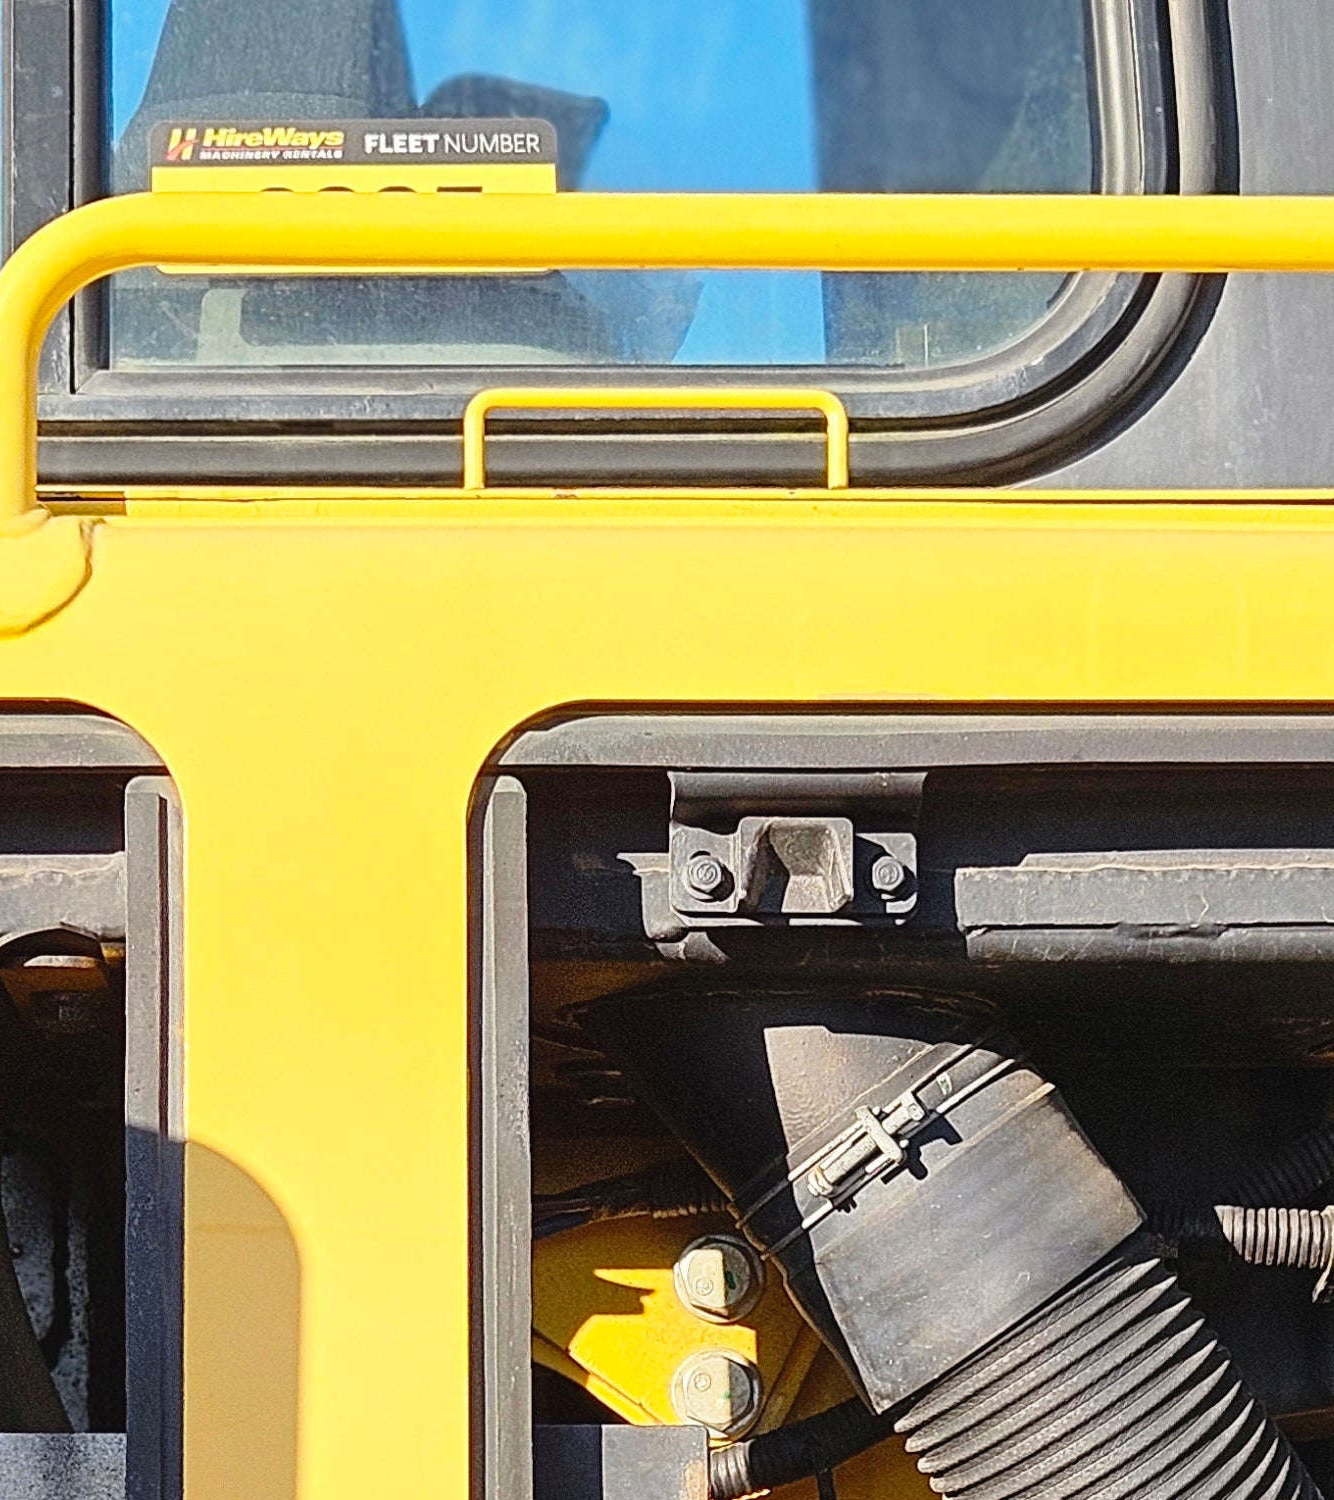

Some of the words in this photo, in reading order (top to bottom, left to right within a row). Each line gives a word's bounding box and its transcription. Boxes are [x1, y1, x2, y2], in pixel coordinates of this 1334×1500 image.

[202, 127, 345, 148] HireWays
[365, 133, 440, 154] FLEET
[444, 132, 540, 154] NUMBER
[199, 150, 279, 160] MACHINERY
[282, 149, 344, 160] RENTALS
